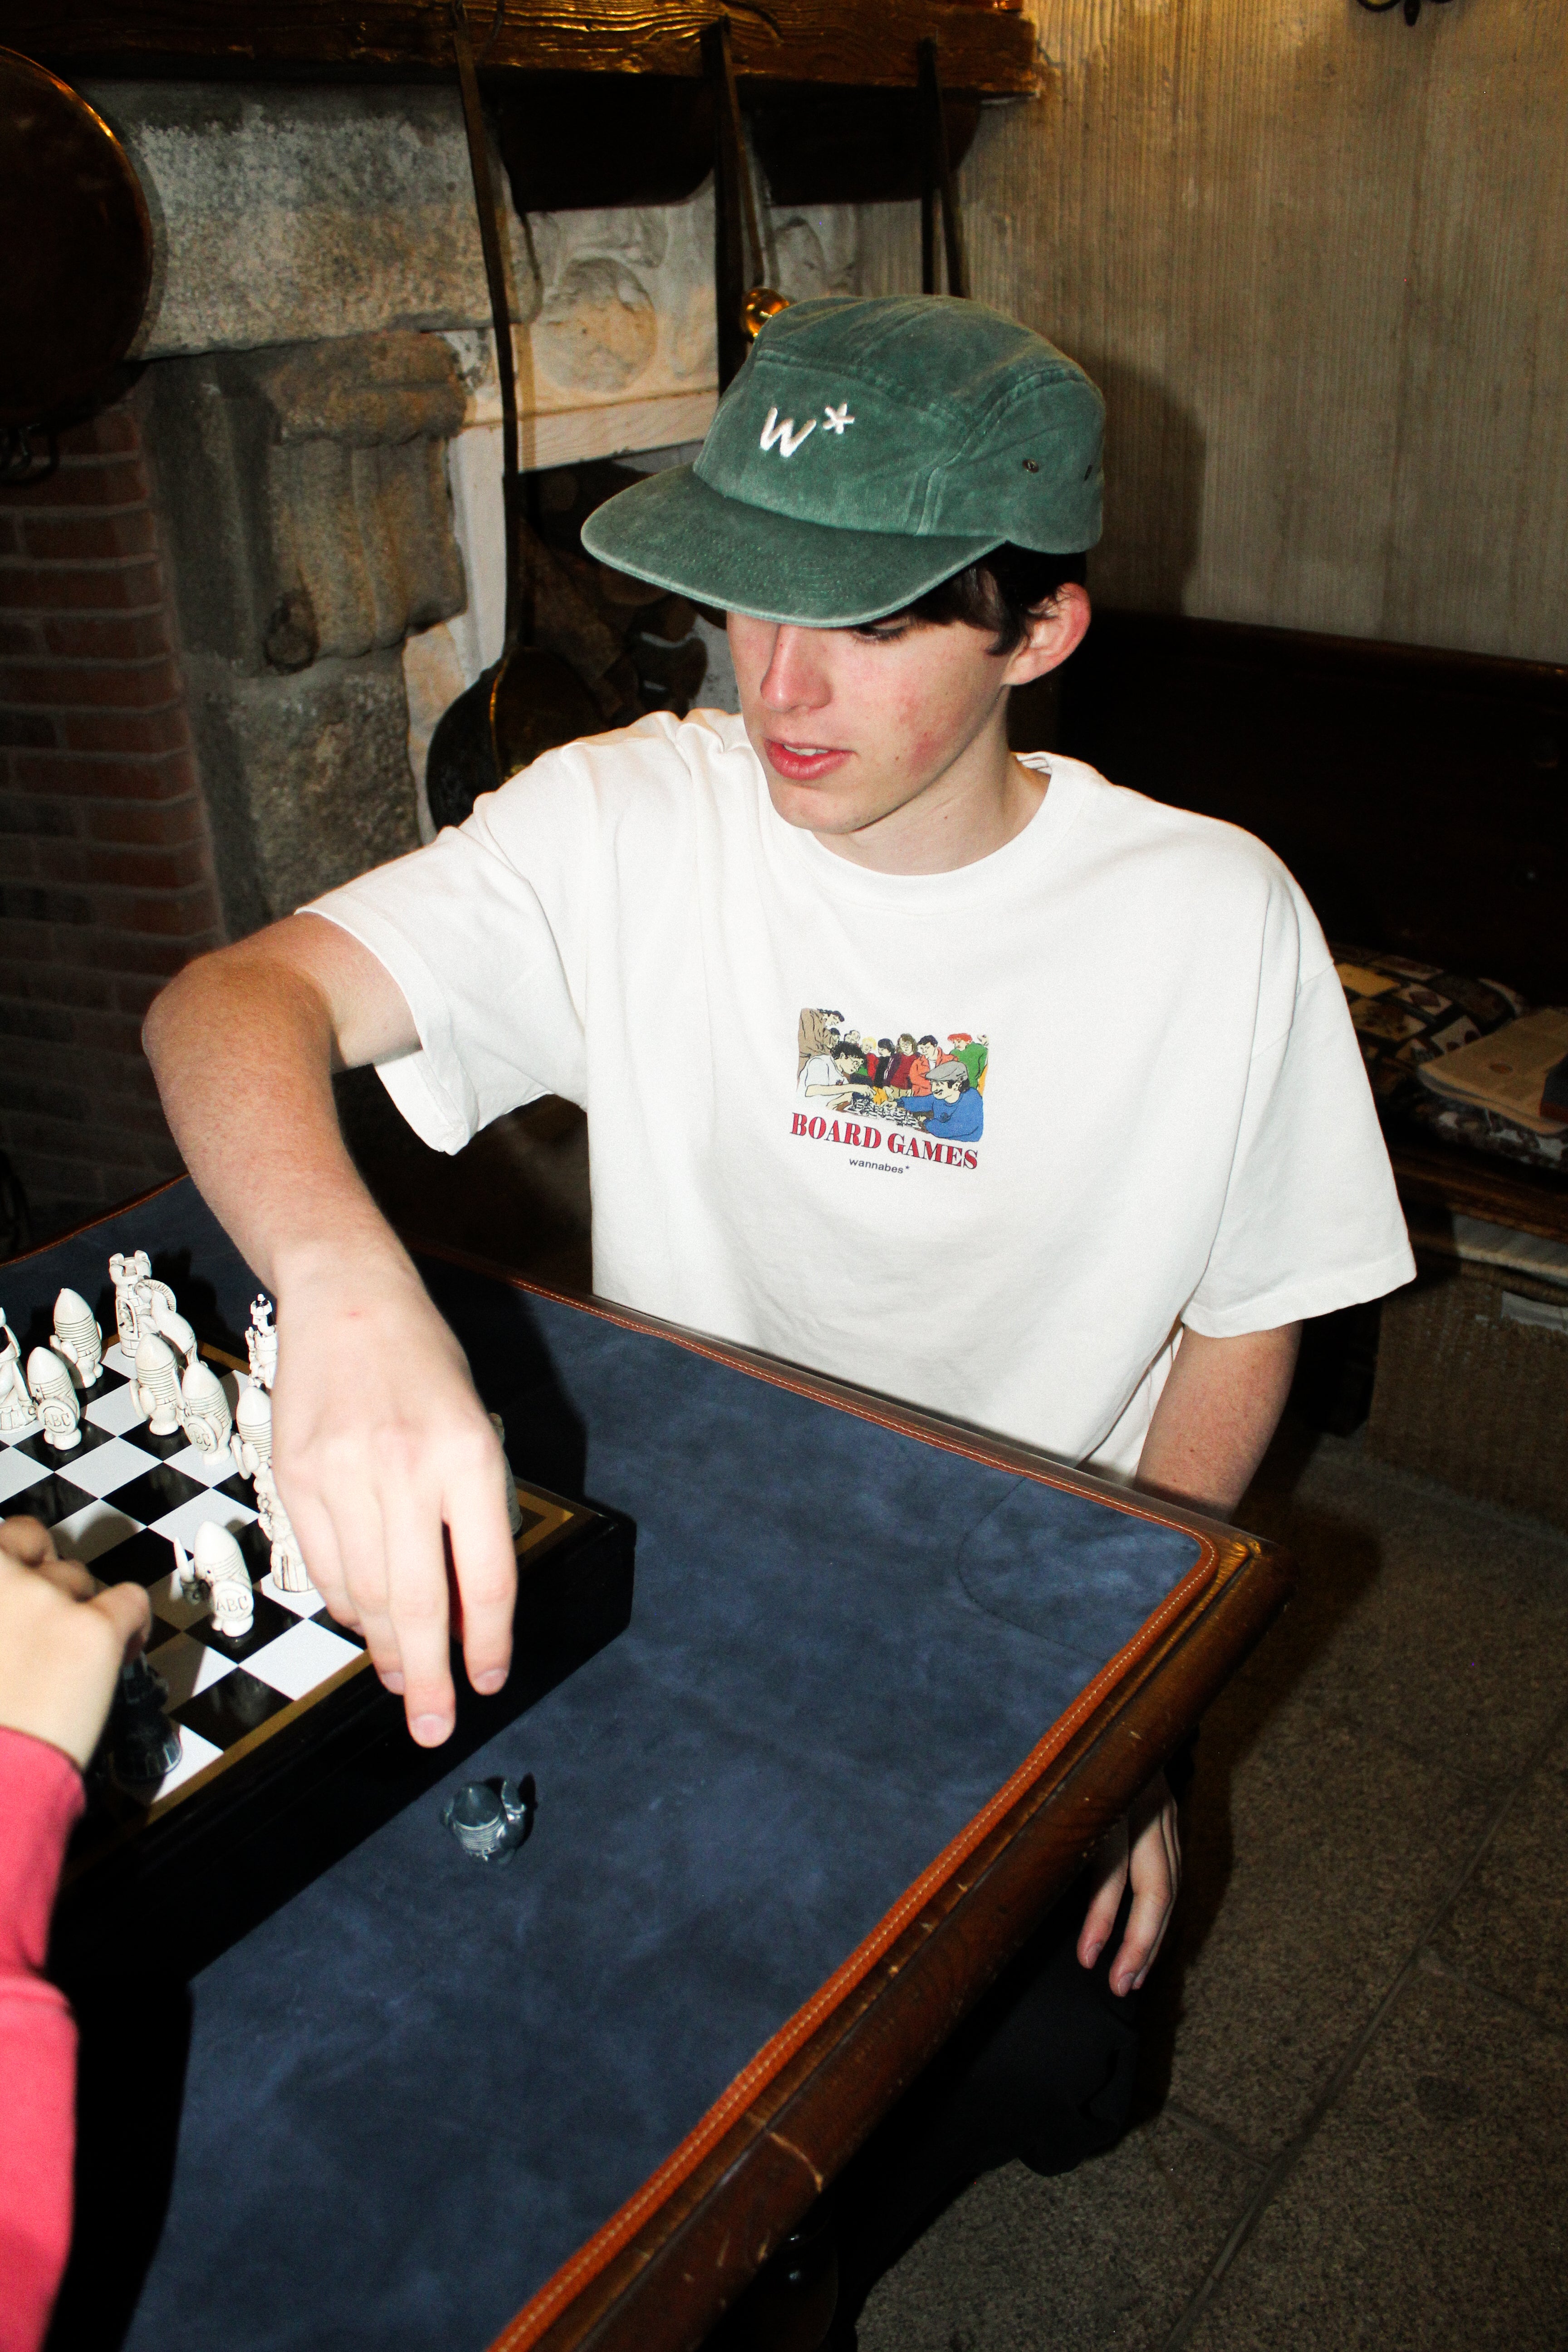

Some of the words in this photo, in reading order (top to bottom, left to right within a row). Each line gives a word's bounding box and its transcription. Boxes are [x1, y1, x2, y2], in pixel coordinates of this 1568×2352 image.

[790, 1112, 881, 1149] BOARD
[887, 1132, 978, 1170] GAMES
[44, 1412, 70, 1426] ABC
[217, 1595, 249, 1612] ABC
